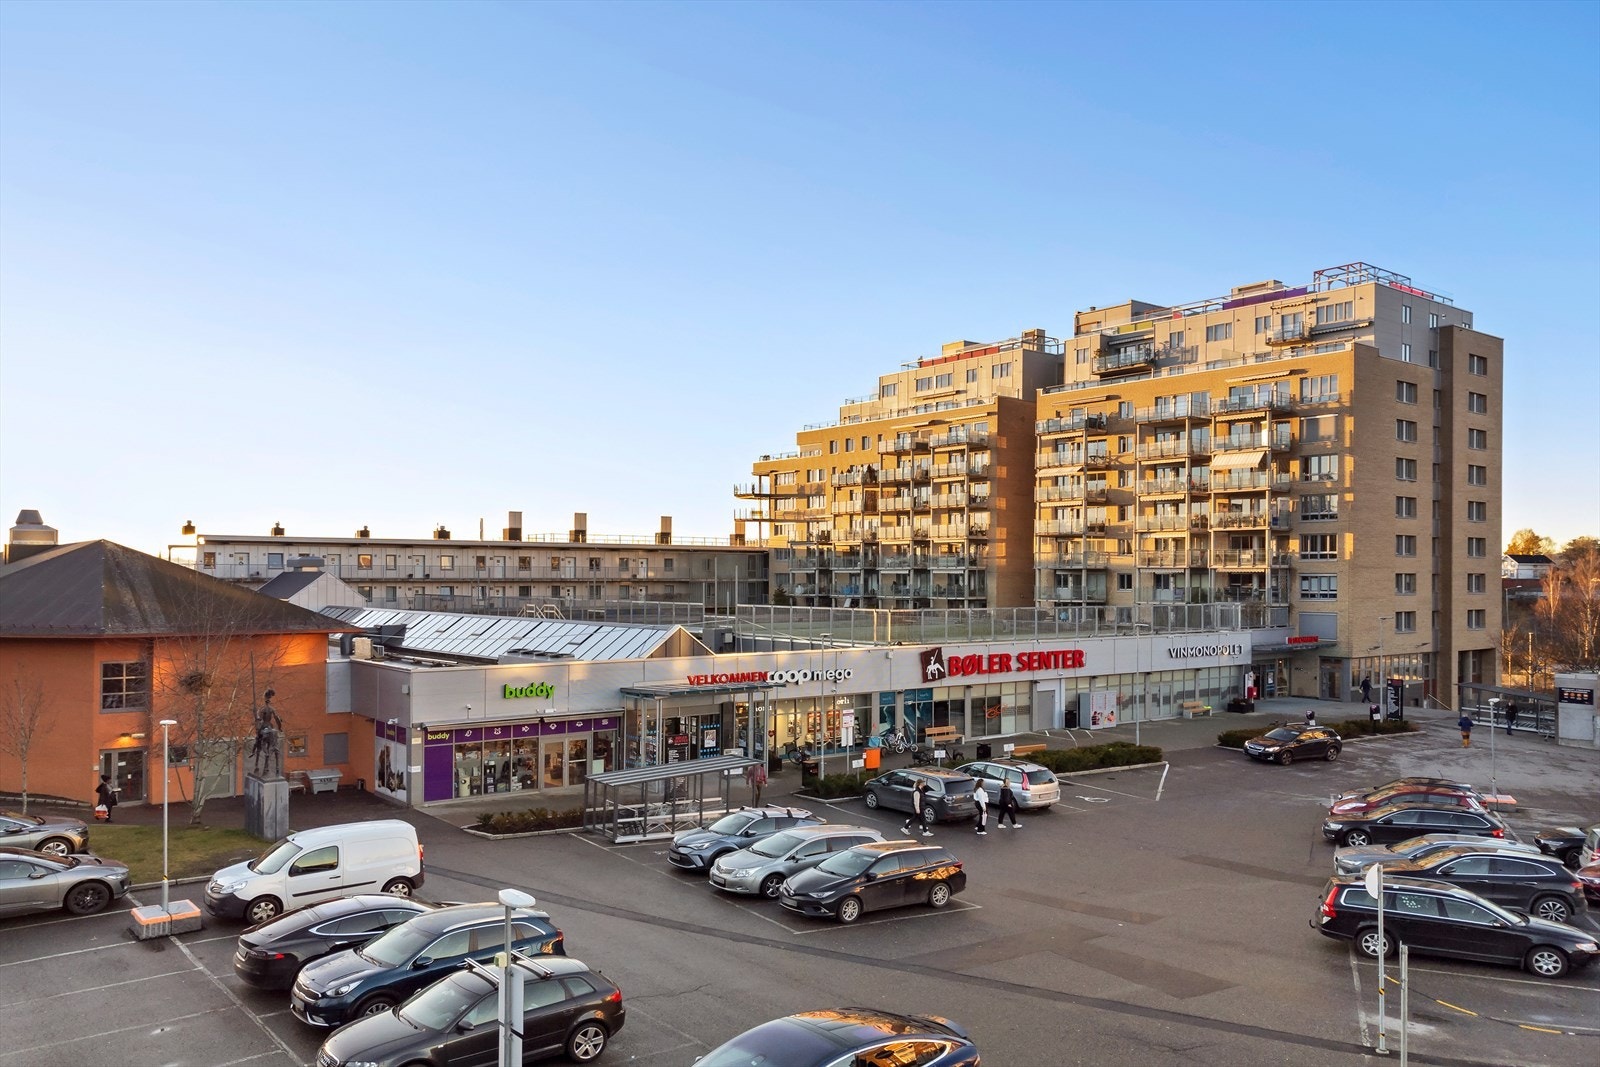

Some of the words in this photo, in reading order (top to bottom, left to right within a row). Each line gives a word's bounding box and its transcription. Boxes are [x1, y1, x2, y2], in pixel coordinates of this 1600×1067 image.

[1169, 644, 1243, 658] VINMONOPOLET
[948, 653, 1012, 677] BØLER
[1017, 650, 1085, 672] SENTER
[687, 671, 768, 686] VELKOMMEN
[766, 669, 813, 686] coop
[813, 668, 854, 684] mega
[504, 681, 556, 699] buddy
[427, 732, 450, 740] buddy
